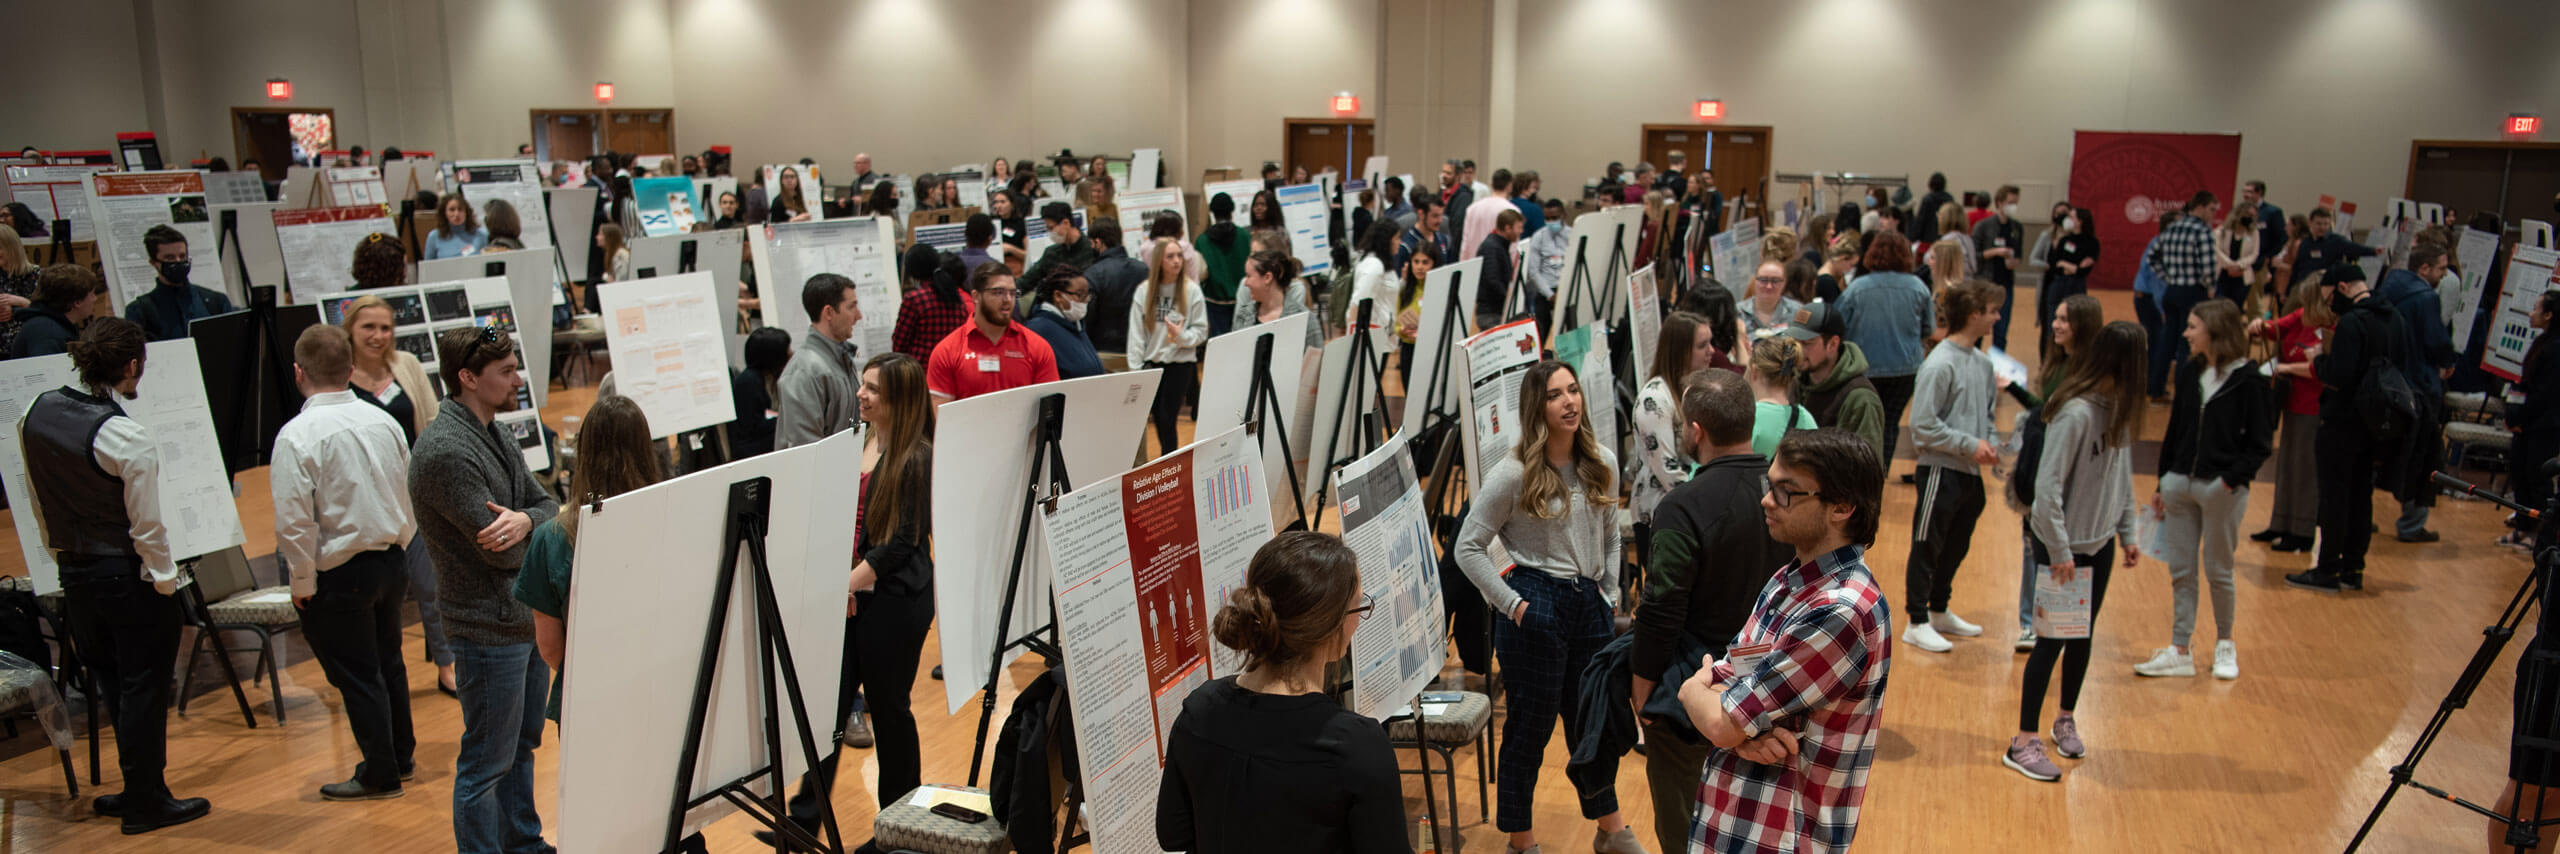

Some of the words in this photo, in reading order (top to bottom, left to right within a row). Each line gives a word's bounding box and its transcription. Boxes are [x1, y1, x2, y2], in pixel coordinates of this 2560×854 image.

[2515, 118, 2534, 132] EXIT
[1133, 475, 1152, 490] Relative
[1152, 472, 1161, 483] Age
[1162, 466, 1177, 478] Effects
[1136, 487, 1155, 504] Division
[1158, 476, 1179, 494] Volleyball
